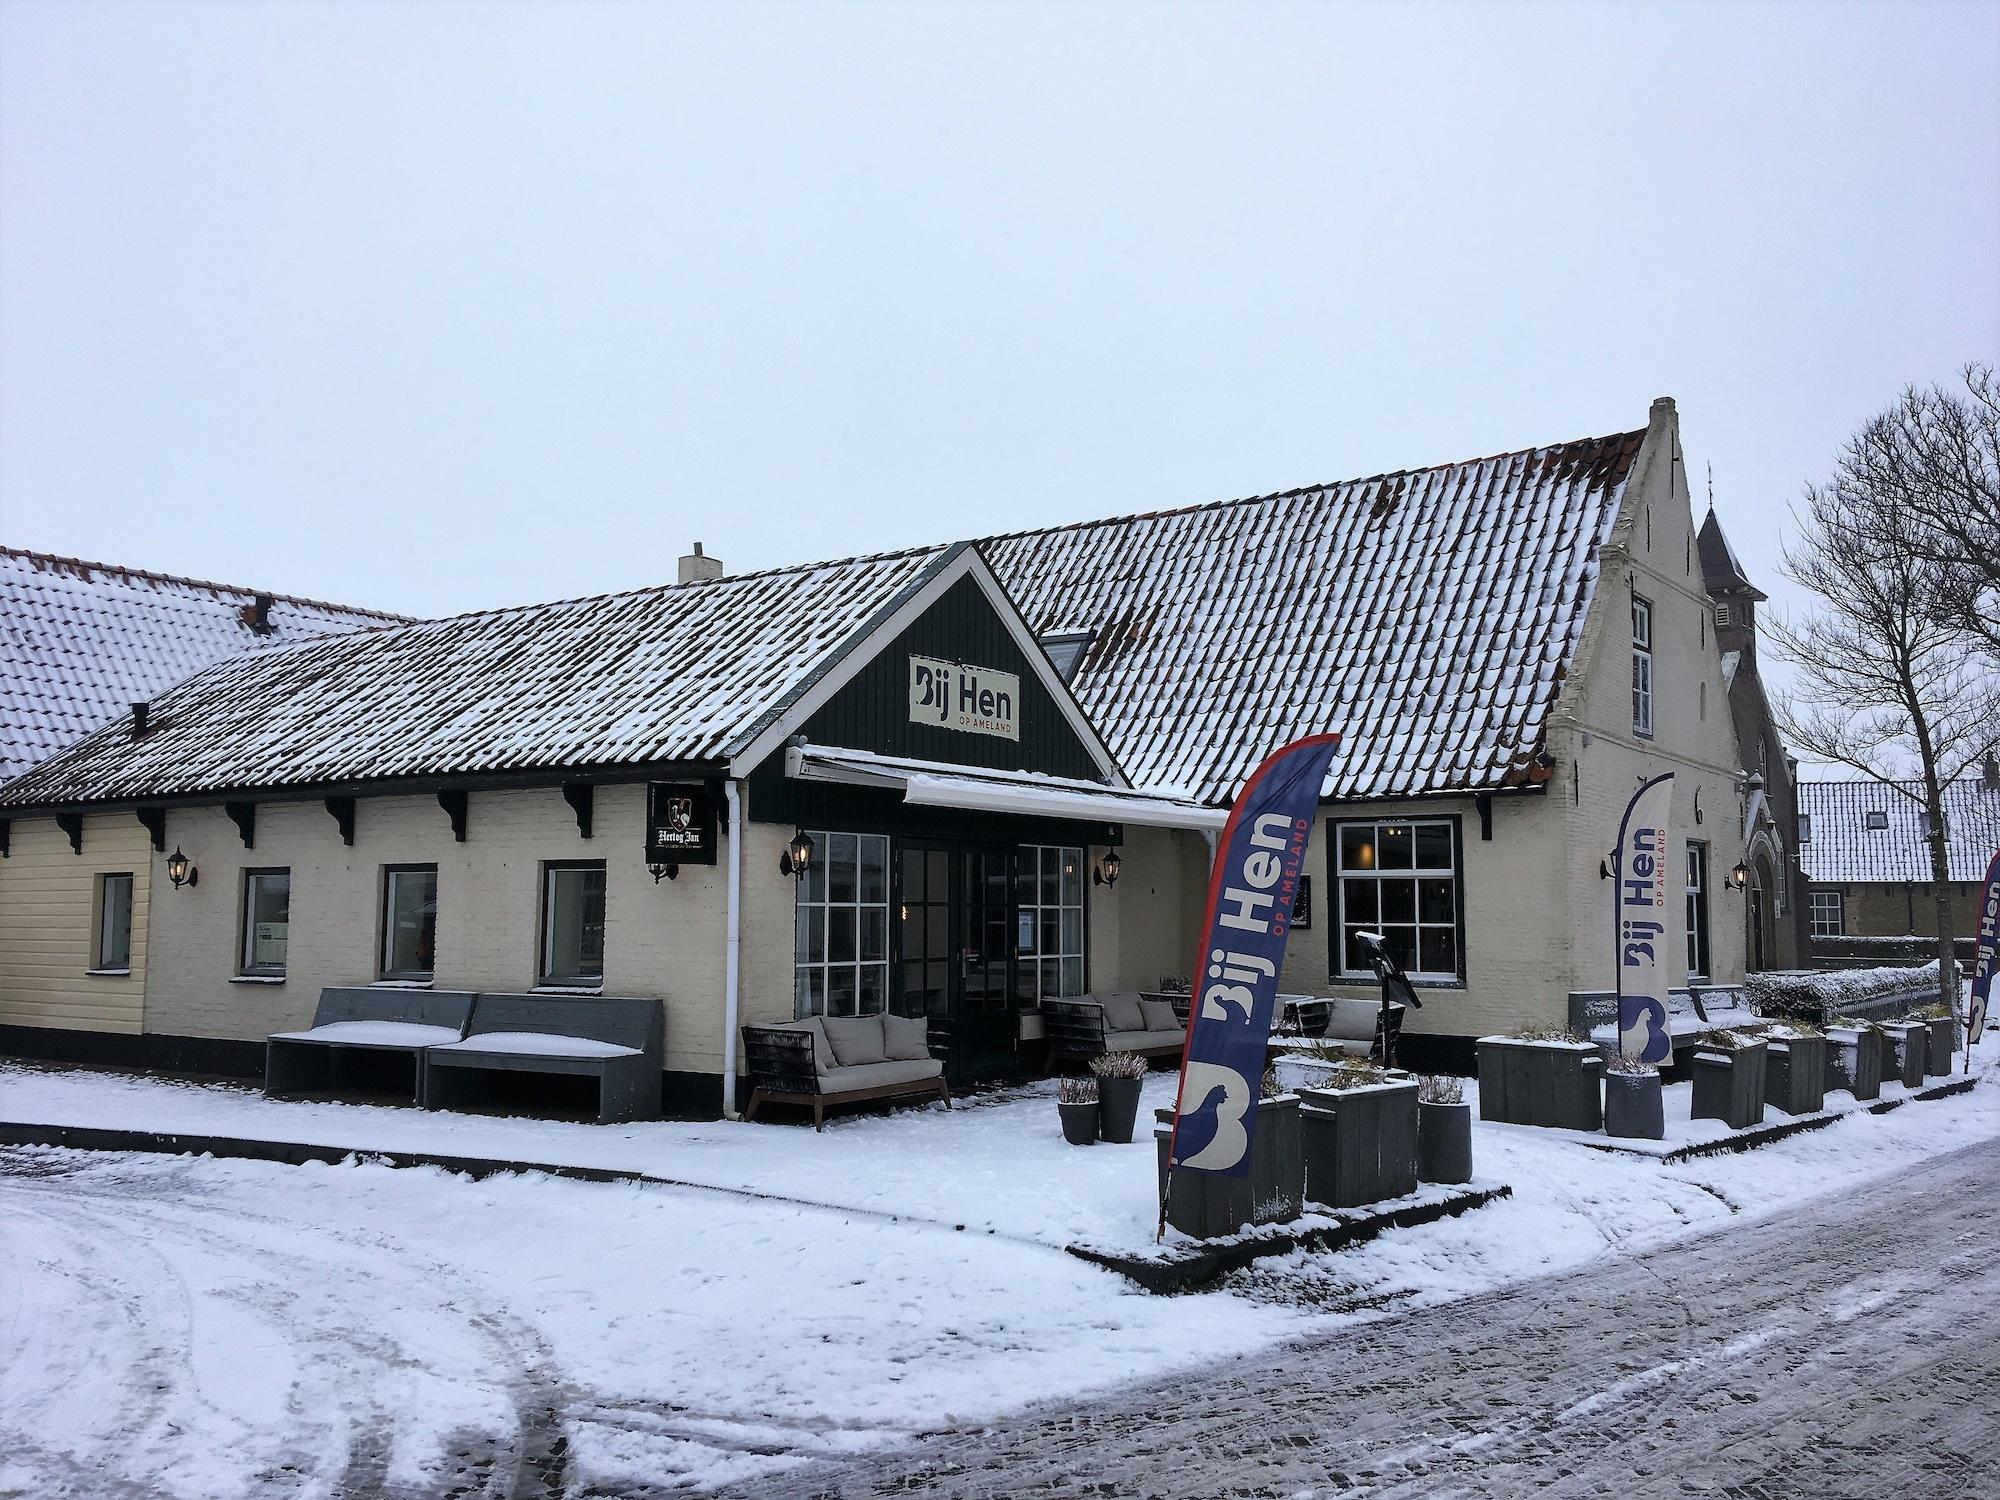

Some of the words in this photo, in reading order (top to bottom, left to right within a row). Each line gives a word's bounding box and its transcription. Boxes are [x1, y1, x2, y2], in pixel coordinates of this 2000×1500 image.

[916, 665, 949, 721] Bij
[960, 674, 1011, 720] Hen
[959, 716, 971, 726] OP
[973, 719, 1012, 733] AMELAND
[658, 830, 684, 844] Hertog
[685, 831, 699, 845] Jan
[1657, 829, 1665, 887] AMELAND
[1219, 812, 1292, 934] Hen
[1273, 912, 1286, 936] OP
[1280, 819, 1308, 906] AMELAND
[1624, 828, 1655, 906] Hen
[1656, 891, 1664, 907] OP
[1981, 882, 2000, 937] Hen
[1623, 920, 1664, 967] Bij
[1976, 944, 1995, 978] Bij
[1201, 949, 1276, 1025] Bij
